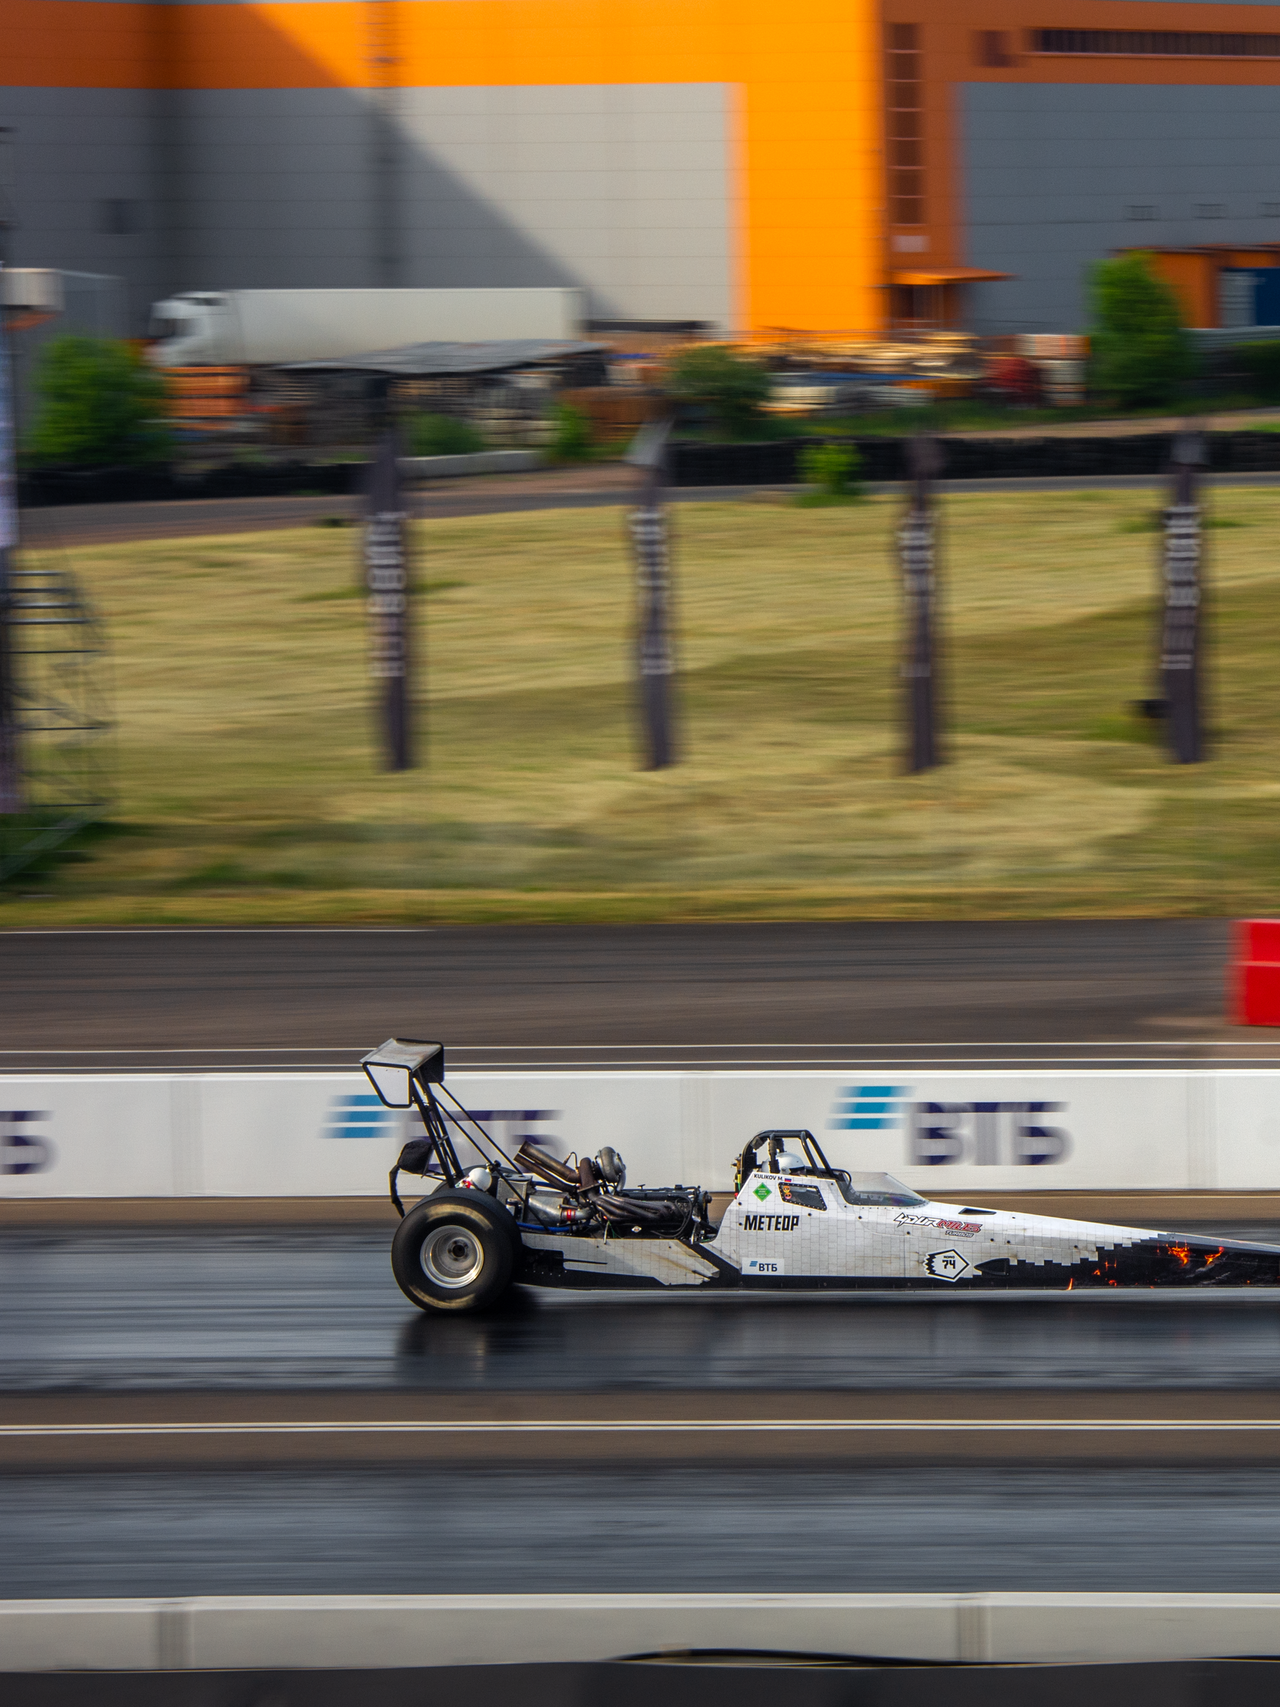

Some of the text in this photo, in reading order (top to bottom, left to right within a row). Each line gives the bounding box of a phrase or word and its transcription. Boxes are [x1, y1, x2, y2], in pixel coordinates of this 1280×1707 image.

[905, 1101, 1073, 1166] ВТБ
[743, 1214, 800, 1231] МЕТЕОР
[758, 1263, 778, 1272] ВТБ
[942, 1259, 956, 1270] 74
